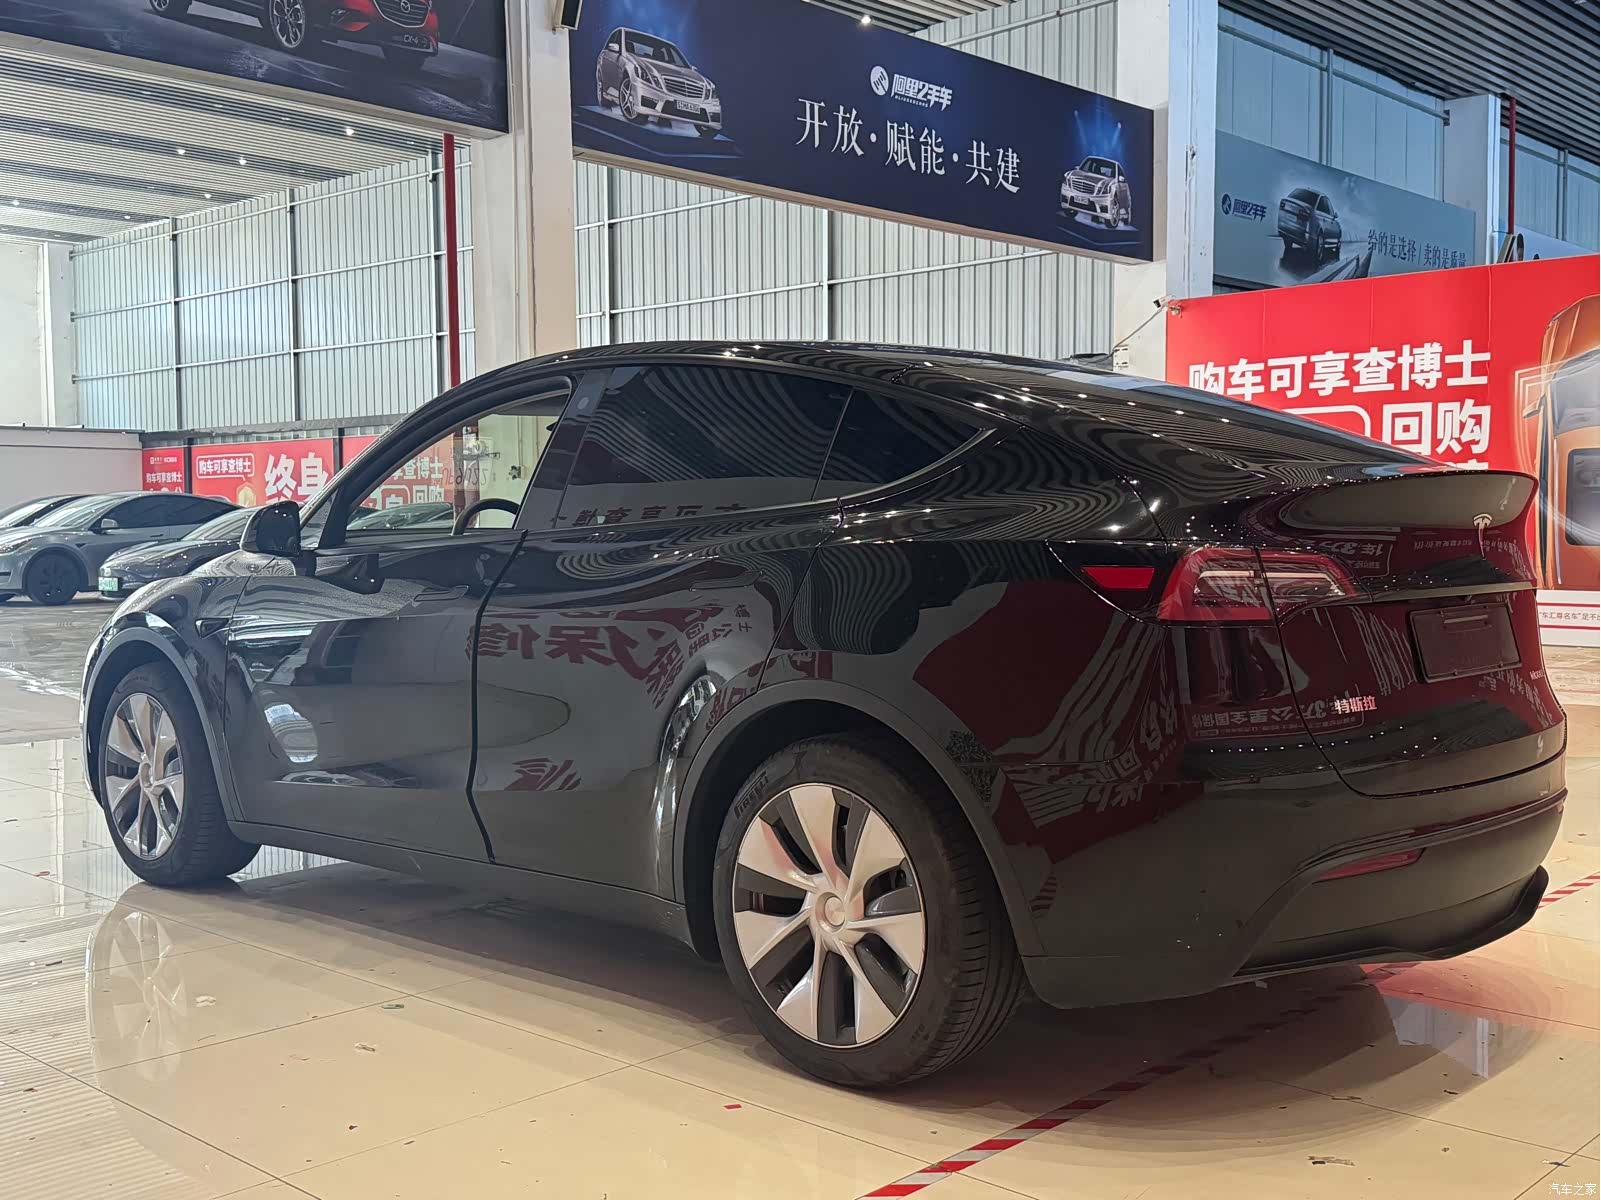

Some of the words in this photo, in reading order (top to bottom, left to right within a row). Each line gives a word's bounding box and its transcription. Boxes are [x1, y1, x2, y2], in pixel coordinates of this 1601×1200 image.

[1367, 228, 1417, 264] 给的是选择
[1188, 339, 1492, 401] 购车可享查博士
[1383, 398, 1491, 456] 回购
[1334, 695, 1378, 715] 特斯拉
